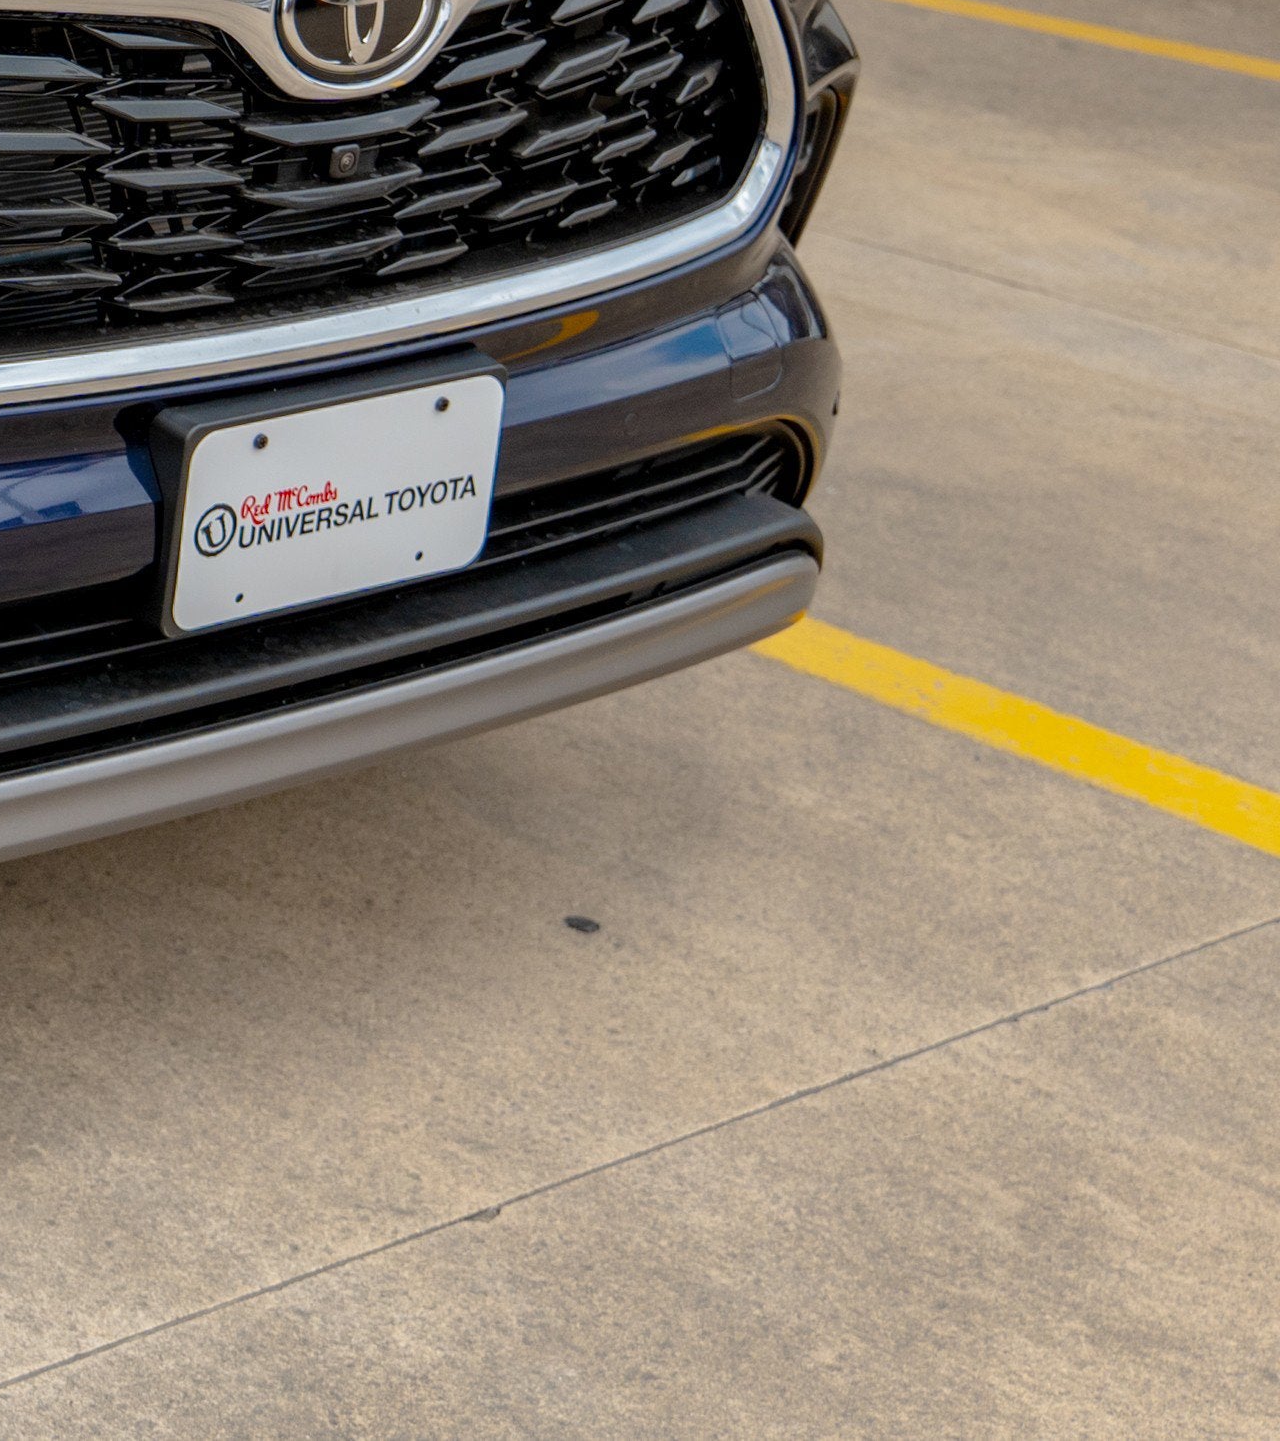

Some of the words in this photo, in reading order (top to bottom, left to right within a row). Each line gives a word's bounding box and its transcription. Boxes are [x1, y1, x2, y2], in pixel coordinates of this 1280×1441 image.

[239, 497, 379, 549] UNIVERSAL
[385, 475, 477, 517] TOYOTA
[241, 494, 271, 525] Red
[274, 480, 338, 512] McCombs
